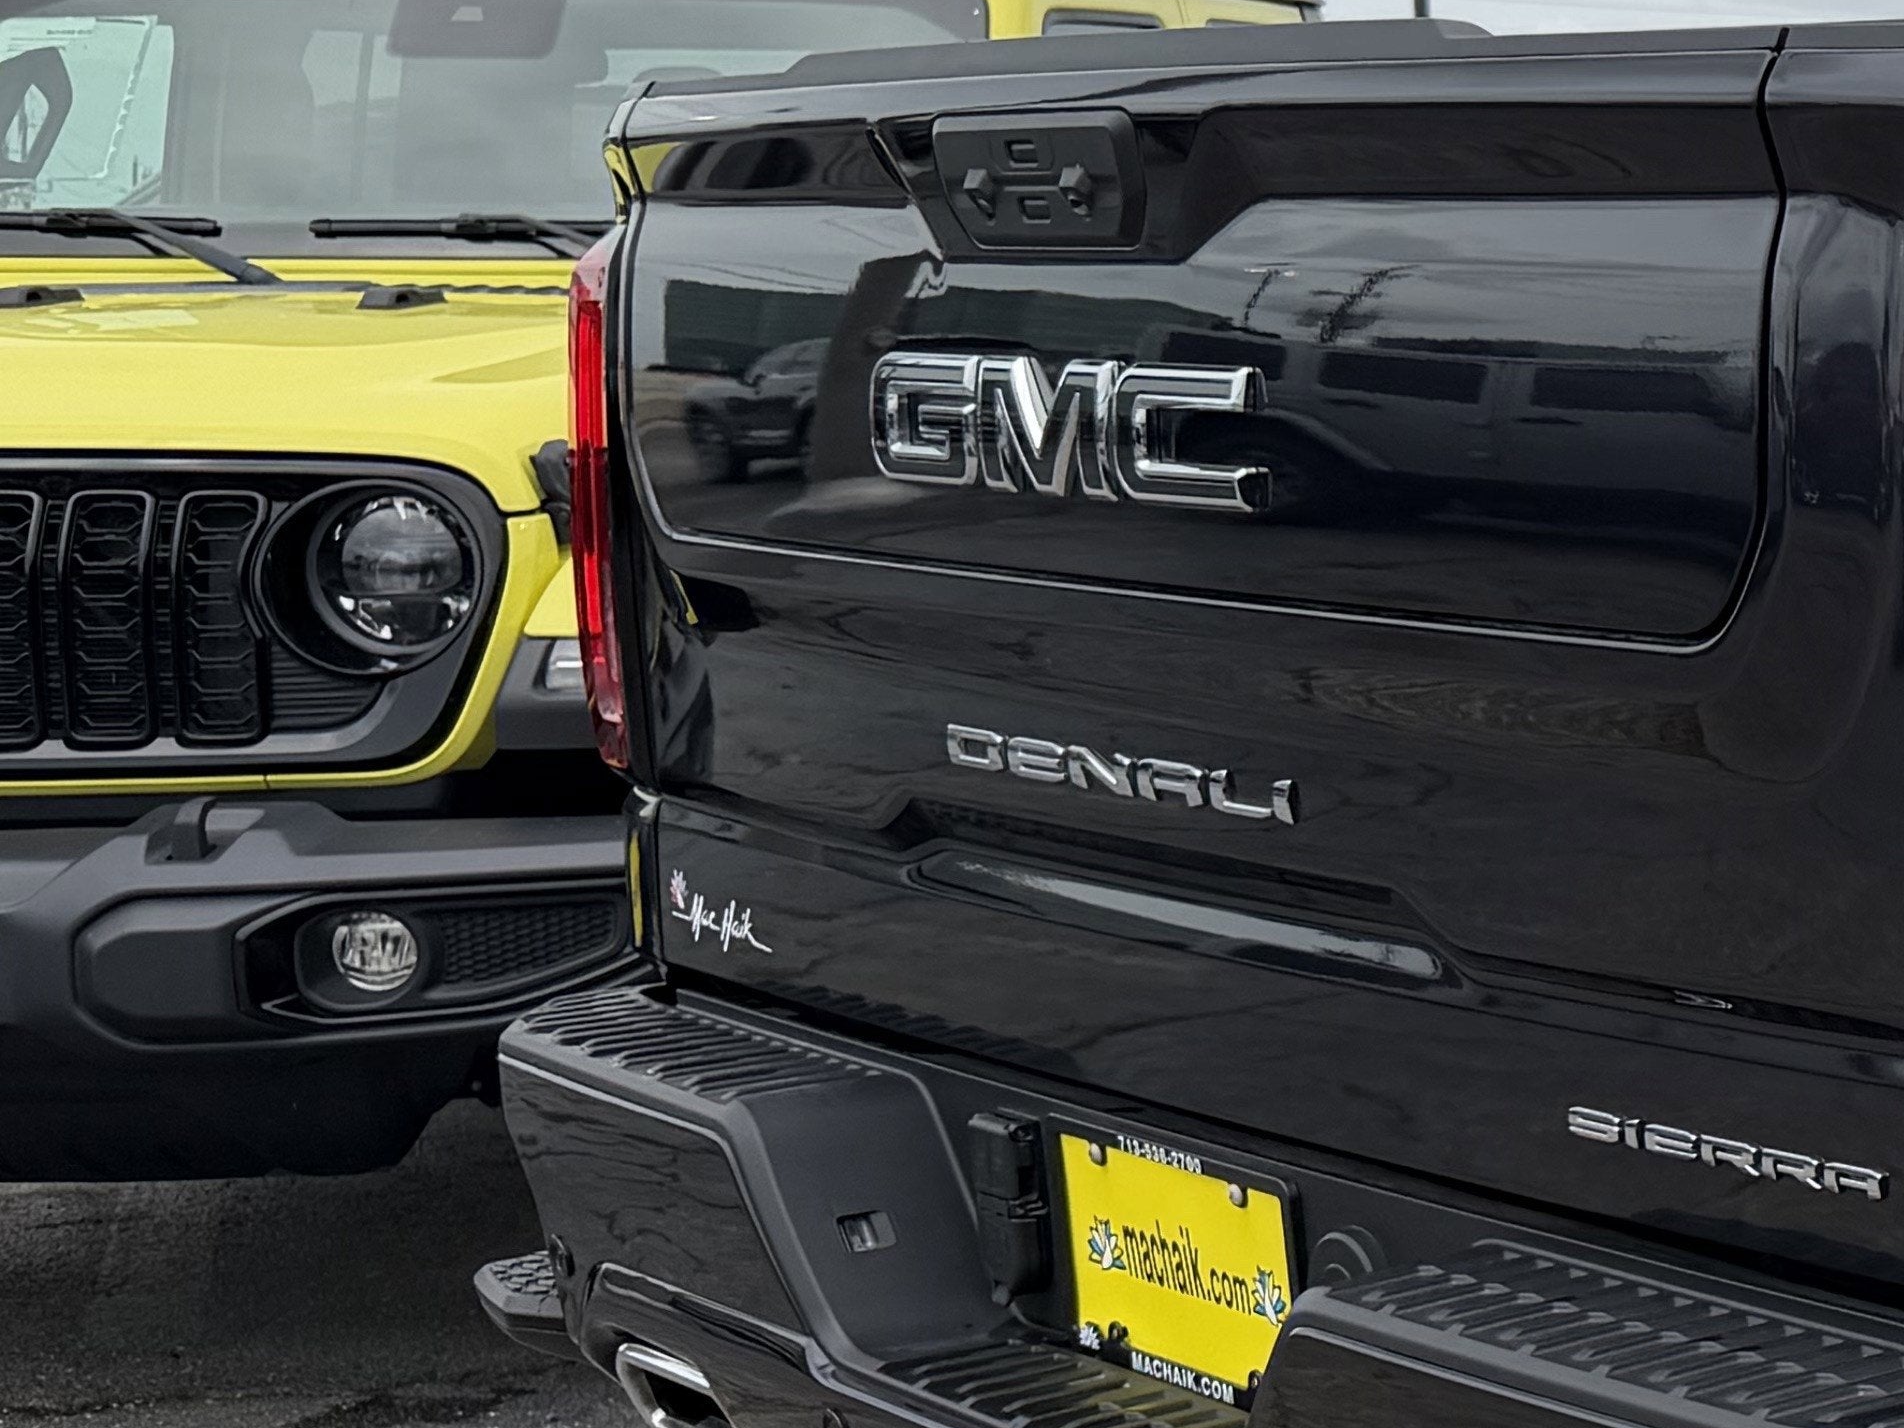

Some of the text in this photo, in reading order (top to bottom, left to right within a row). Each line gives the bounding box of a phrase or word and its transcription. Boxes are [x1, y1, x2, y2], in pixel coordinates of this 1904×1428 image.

[870, 350, 1271, 513] GMC
[947, 723, 1300, 826] DENALI
[1568, 1106, 1890, 1200] SIERRA
[1122, 1219, 1252, 1315] machaik.com
[1131, 1351, 1235, 1405] MACHAIK.COM
